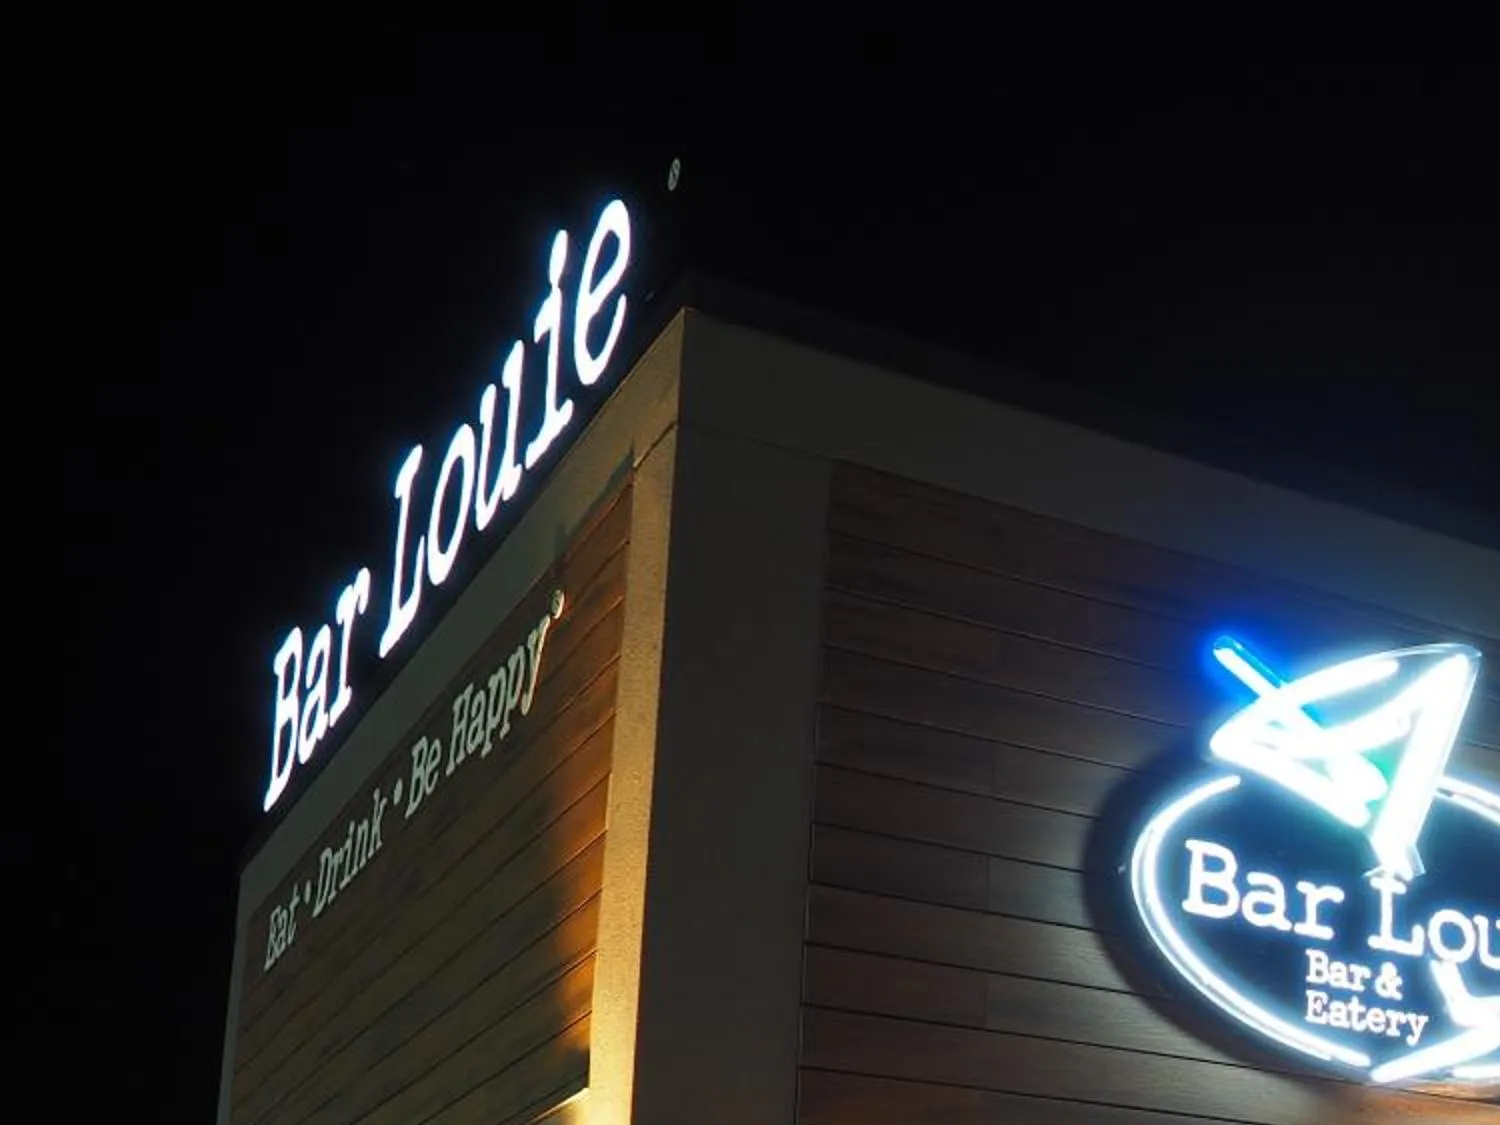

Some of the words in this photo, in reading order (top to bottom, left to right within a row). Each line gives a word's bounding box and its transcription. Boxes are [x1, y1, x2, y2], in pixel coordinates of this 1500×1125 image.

[263, 567, 371, 813] Bar
[378, 198, 632, 659] Louie
[264, 885, 300, 970] Eat
[313, 788, 388, 918] Drink
[405, 734, 441, 820] Be
[446, 614, 550, 776] Happy
[1181, 838, 1345, 942] Bar
[1305, 948, 1371, 993] Bar
[1374, 961, 1404, 1001] &
[1305, 992, 1429, 1045] Eatery
